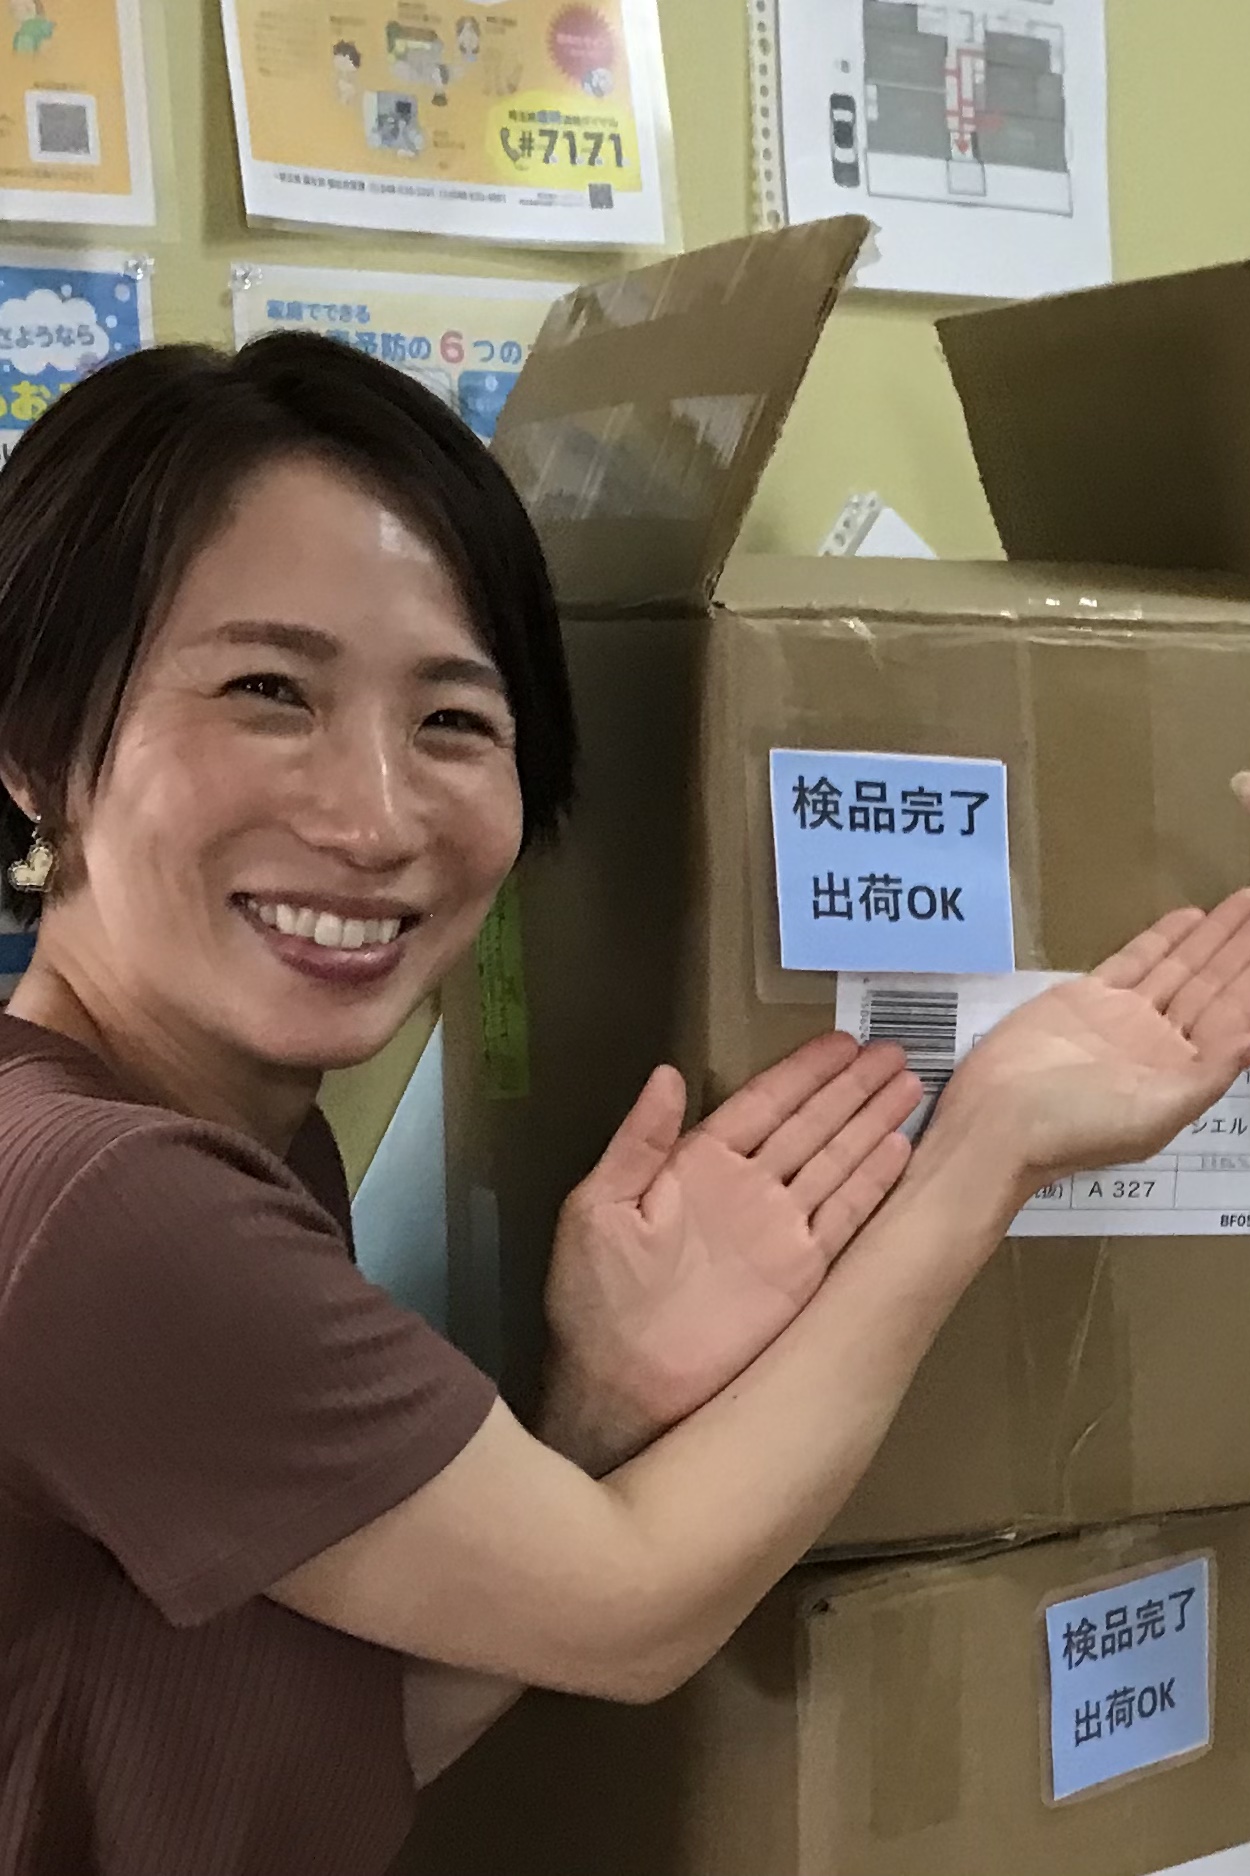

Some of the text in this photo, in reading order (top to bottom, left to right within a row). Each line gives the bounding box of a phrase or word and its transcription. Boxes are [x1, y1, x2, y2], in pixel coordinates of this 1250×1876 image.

[792, 775, 990, 836] 検品完了
[811, 872, 964, 922] 出荷OK
[1088, 1181, 1156, 1198] A 327
[1062, 1588, 1197, 1670] 検品完了
[1074, 1678, 1176, 1748] 出荷OK
